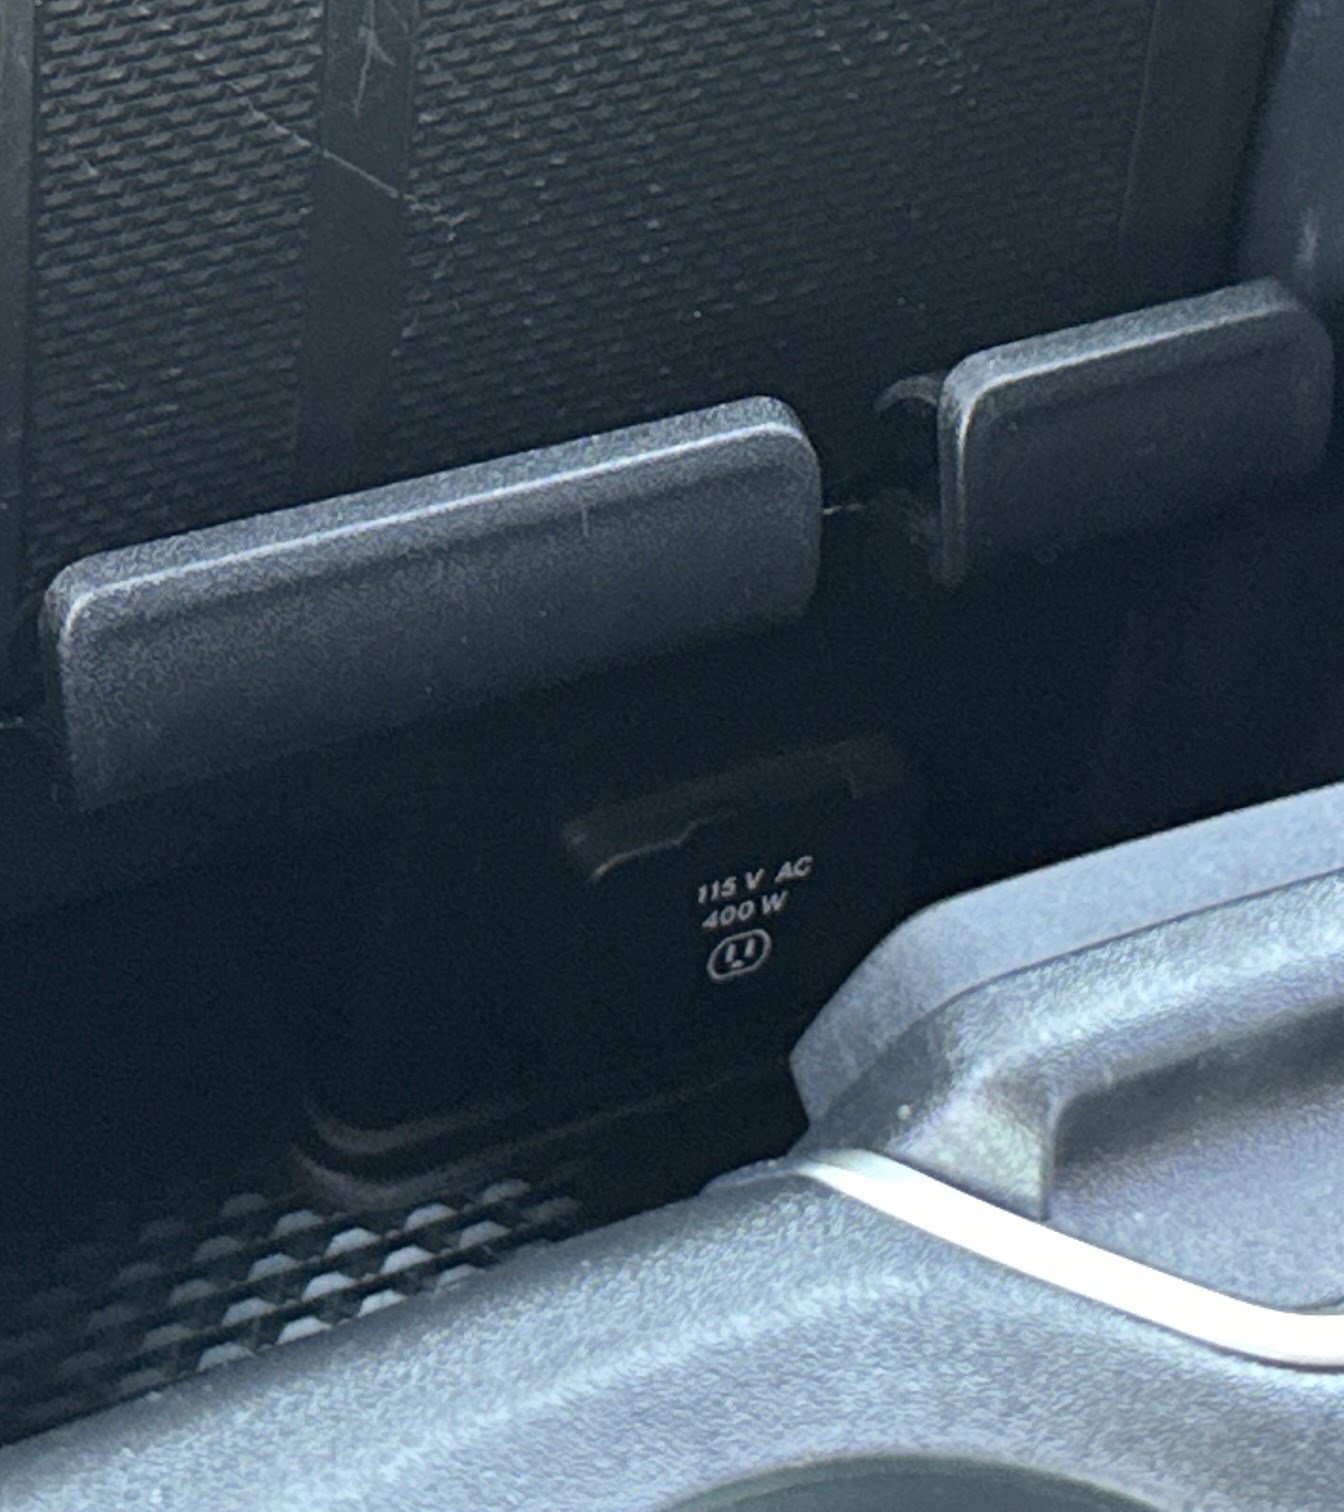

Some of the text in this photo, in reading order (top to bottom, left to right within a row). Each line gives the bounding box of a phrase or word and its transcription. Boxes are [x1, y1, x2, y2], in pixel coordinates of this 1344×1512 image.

[697, 854, 814, 904] 115 V AC
[701, 890, 789, 929] 400 W
